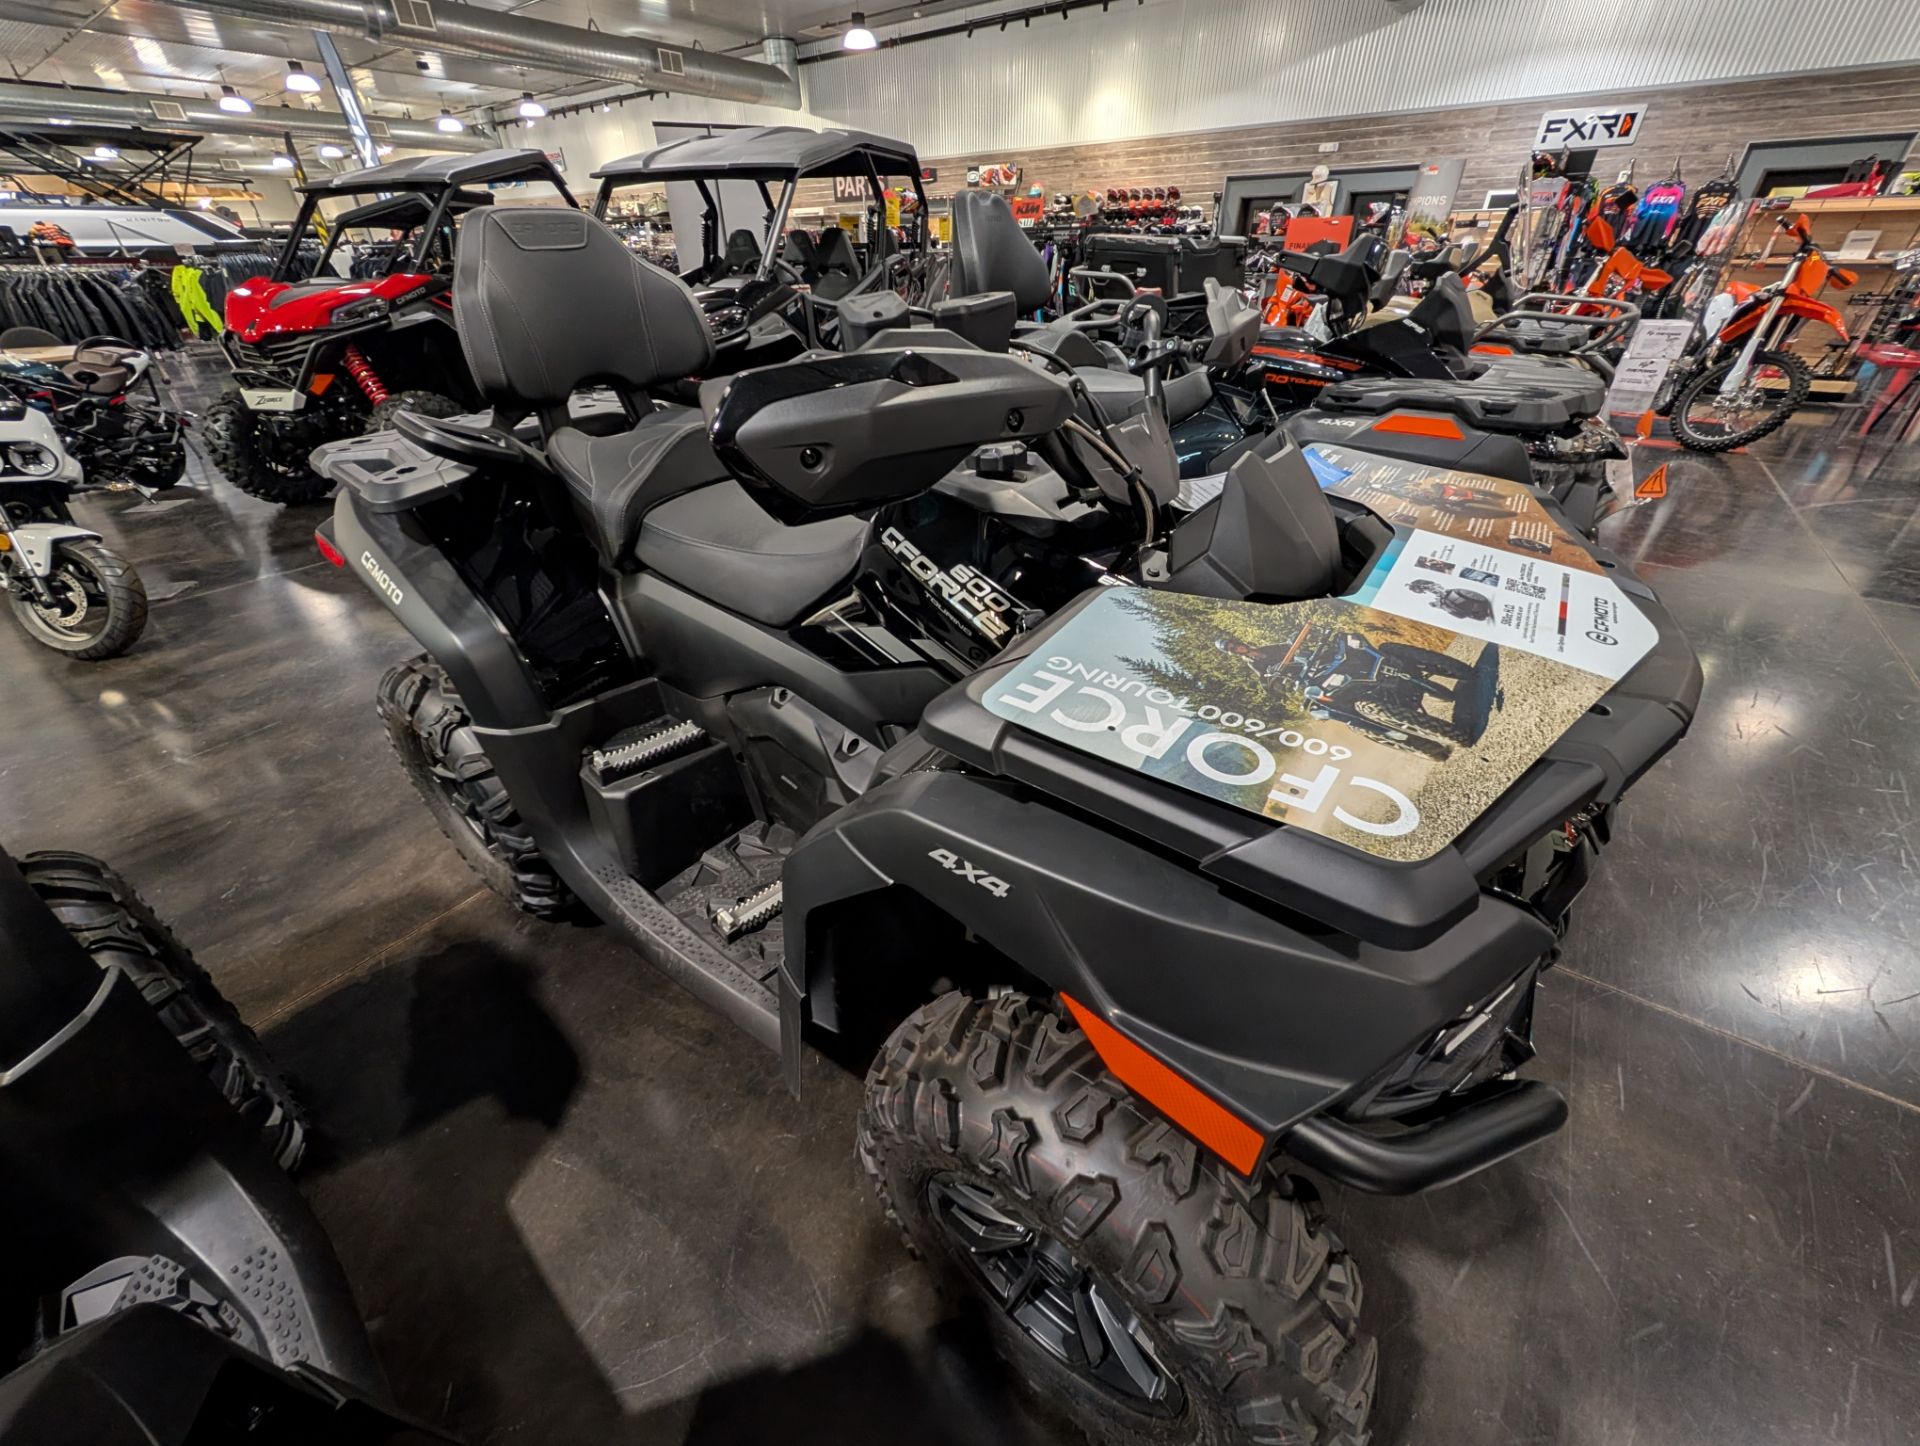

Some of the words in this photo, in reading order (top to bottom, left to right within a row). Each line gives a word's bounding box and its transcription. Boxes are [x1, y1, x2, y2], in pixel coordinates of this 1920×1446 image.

[1016, 202, 1040, 215] KTM
[361, 550, 404, 606] CFMOTO
[881, 526, 1012, 640] CFORCE
[949, 563, 1011, 613] 600
[924, 590, 973, 637] TOURING
[1593, 596, 1610, 632] CFMOTO
[1046, 654, 1195, 713] TOURING
[999, 668, 1420, 837] CFORCE
[1197, 703, 1353, 762] 600/600
